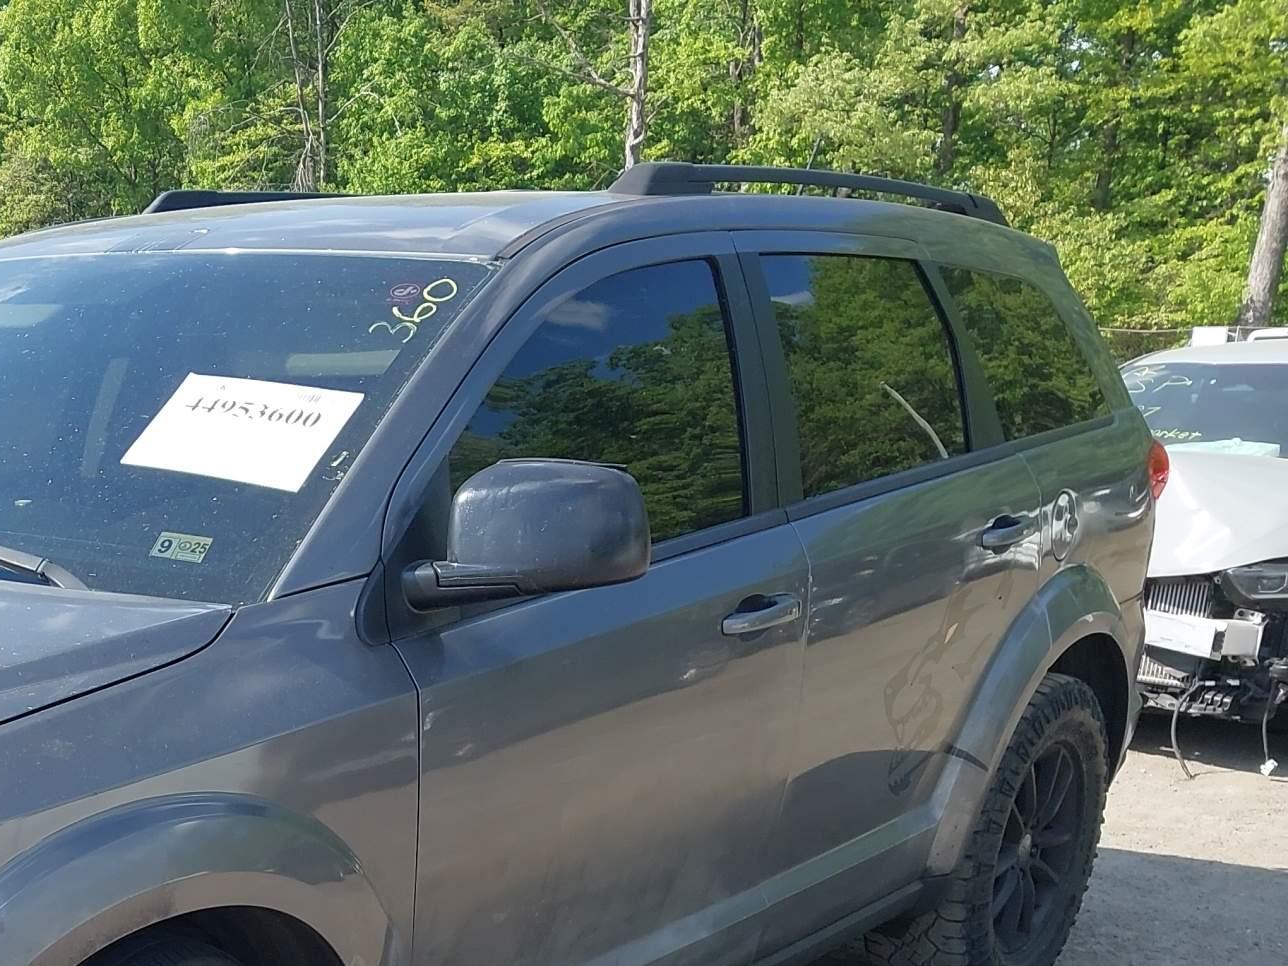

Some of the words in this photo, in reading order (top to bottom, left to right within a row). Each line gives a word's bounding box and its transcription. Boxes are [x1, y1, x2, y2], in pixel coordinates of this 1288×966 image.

[368, 278, 458, 343] 360
[185, 396, 322, 428] 44953600
[157, 539, 173, 553] 9
